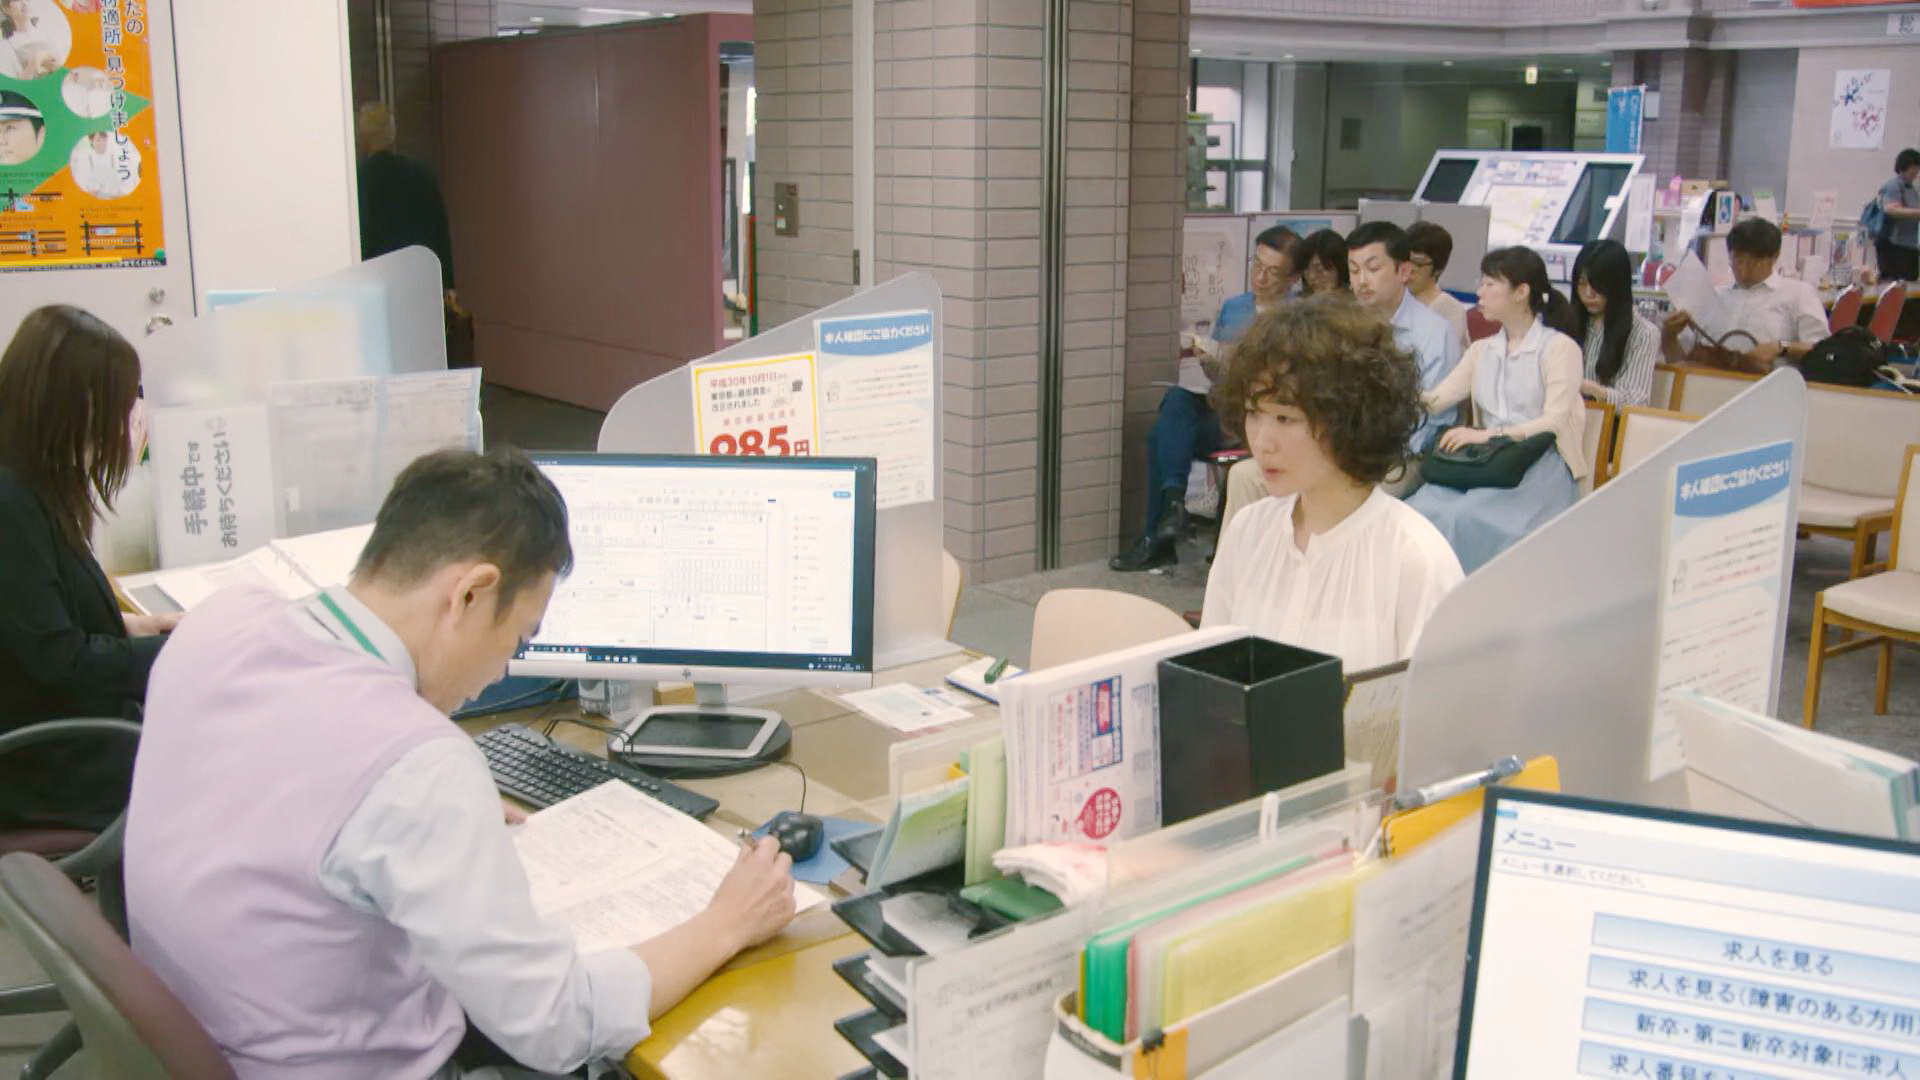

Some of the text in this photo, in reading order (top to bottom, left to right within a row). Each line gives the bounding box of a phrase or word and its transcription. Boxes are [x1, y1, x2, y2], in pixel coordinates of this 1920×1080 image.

[180, 441, 208, 535] 手続中です
[213, 431, 238, 548] お待ちください
[1503, 829, 1577, 851] メニュー
[1723, 940, 1834, 976] 求人を見る
